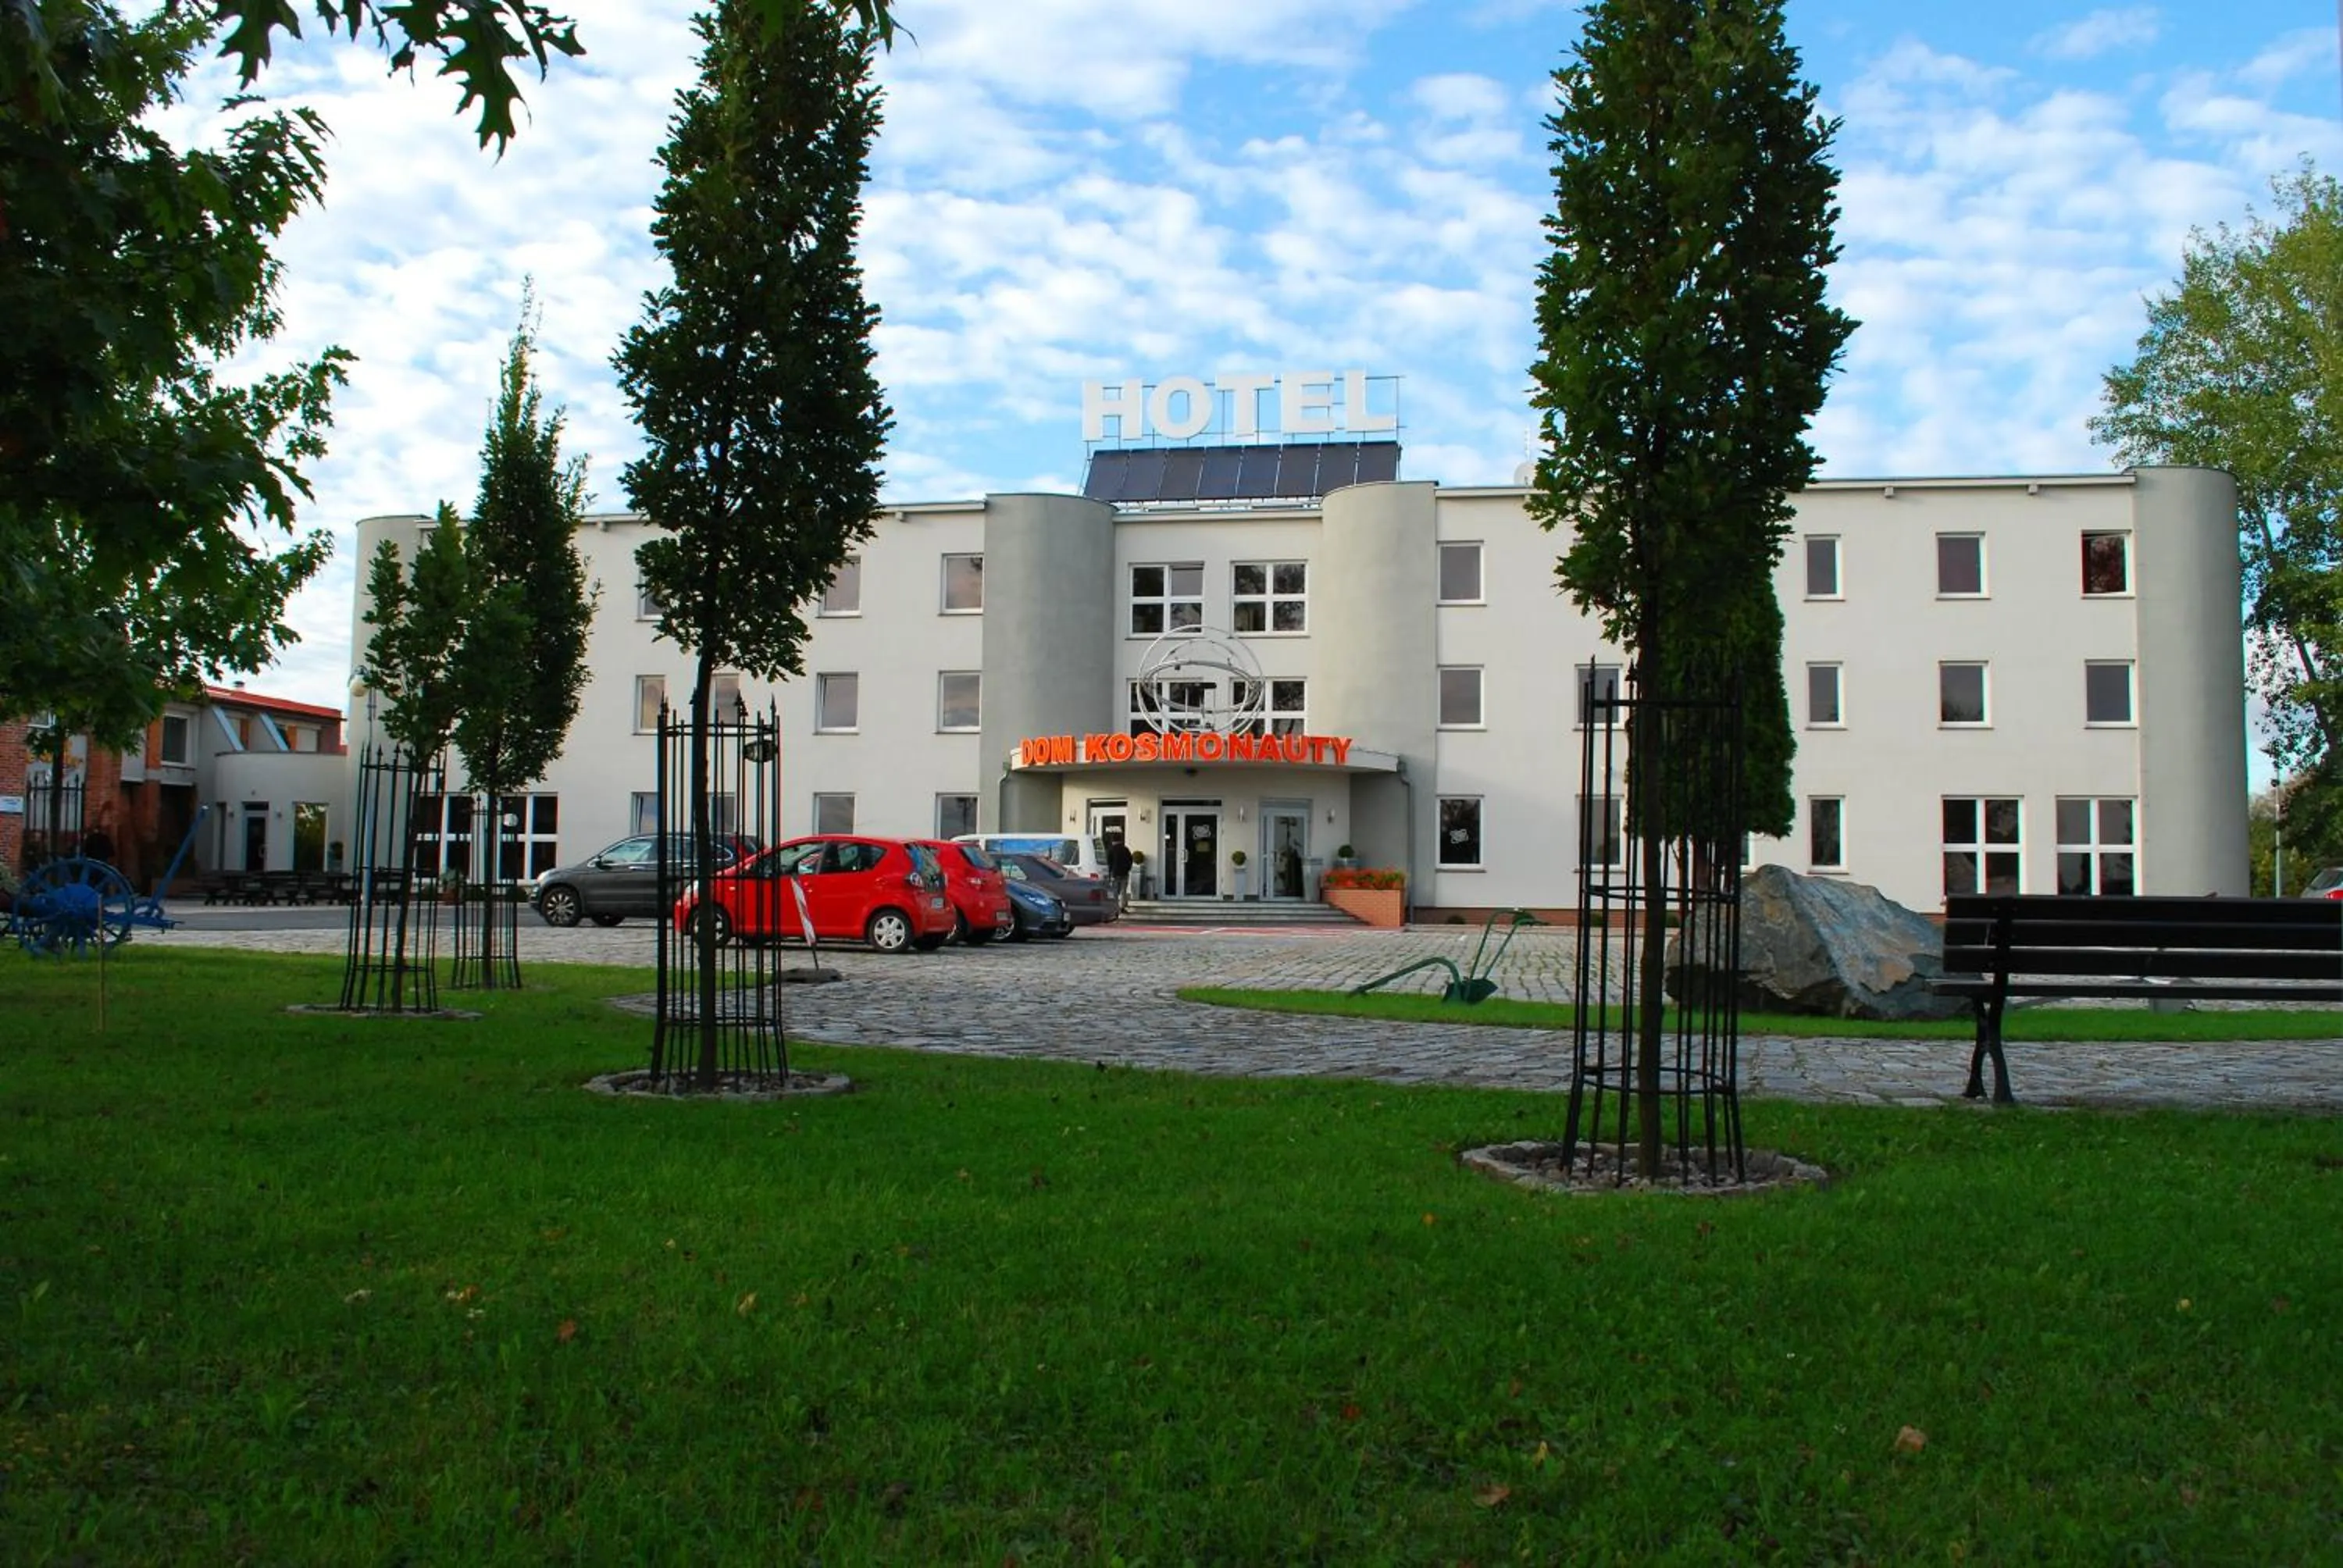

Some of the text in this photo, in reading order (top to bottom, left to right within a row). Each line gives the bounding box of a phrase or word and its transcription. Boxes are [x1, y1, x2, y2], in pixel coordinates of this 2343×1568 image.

[1082, 370, 1396, 441] HOTEL
[1021, 732, 1353, 766] DOM KOSMONAUTY
